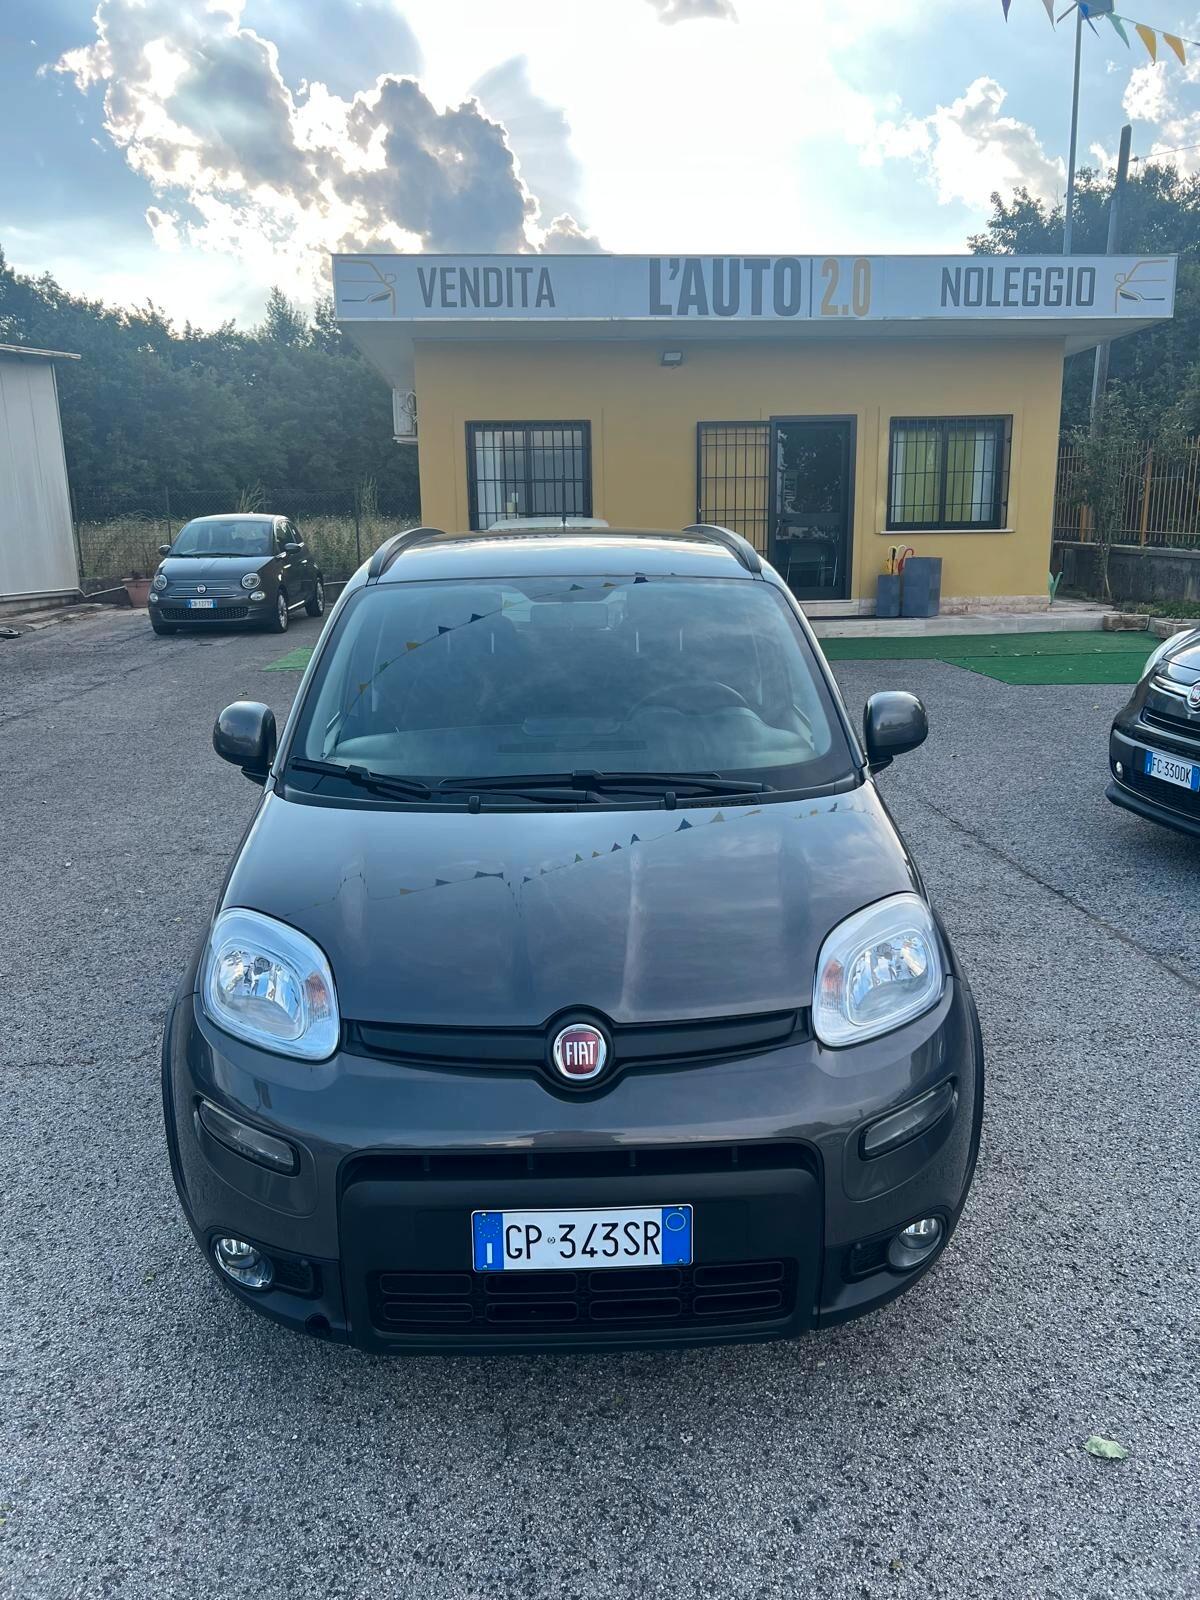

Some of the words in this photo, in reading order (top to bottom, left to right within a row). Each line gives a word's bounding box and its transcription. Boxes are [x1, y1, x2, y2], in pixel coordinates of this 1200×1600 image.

[416, 266, 556, 308] VENDITA
[648, 257, 802, 317] L'AUTO
[820, 257, 872, 317] 2.0
[940, 266, 1096, 307] NOLEGGIO
[565, 1040, 596, 1066] FIAT
